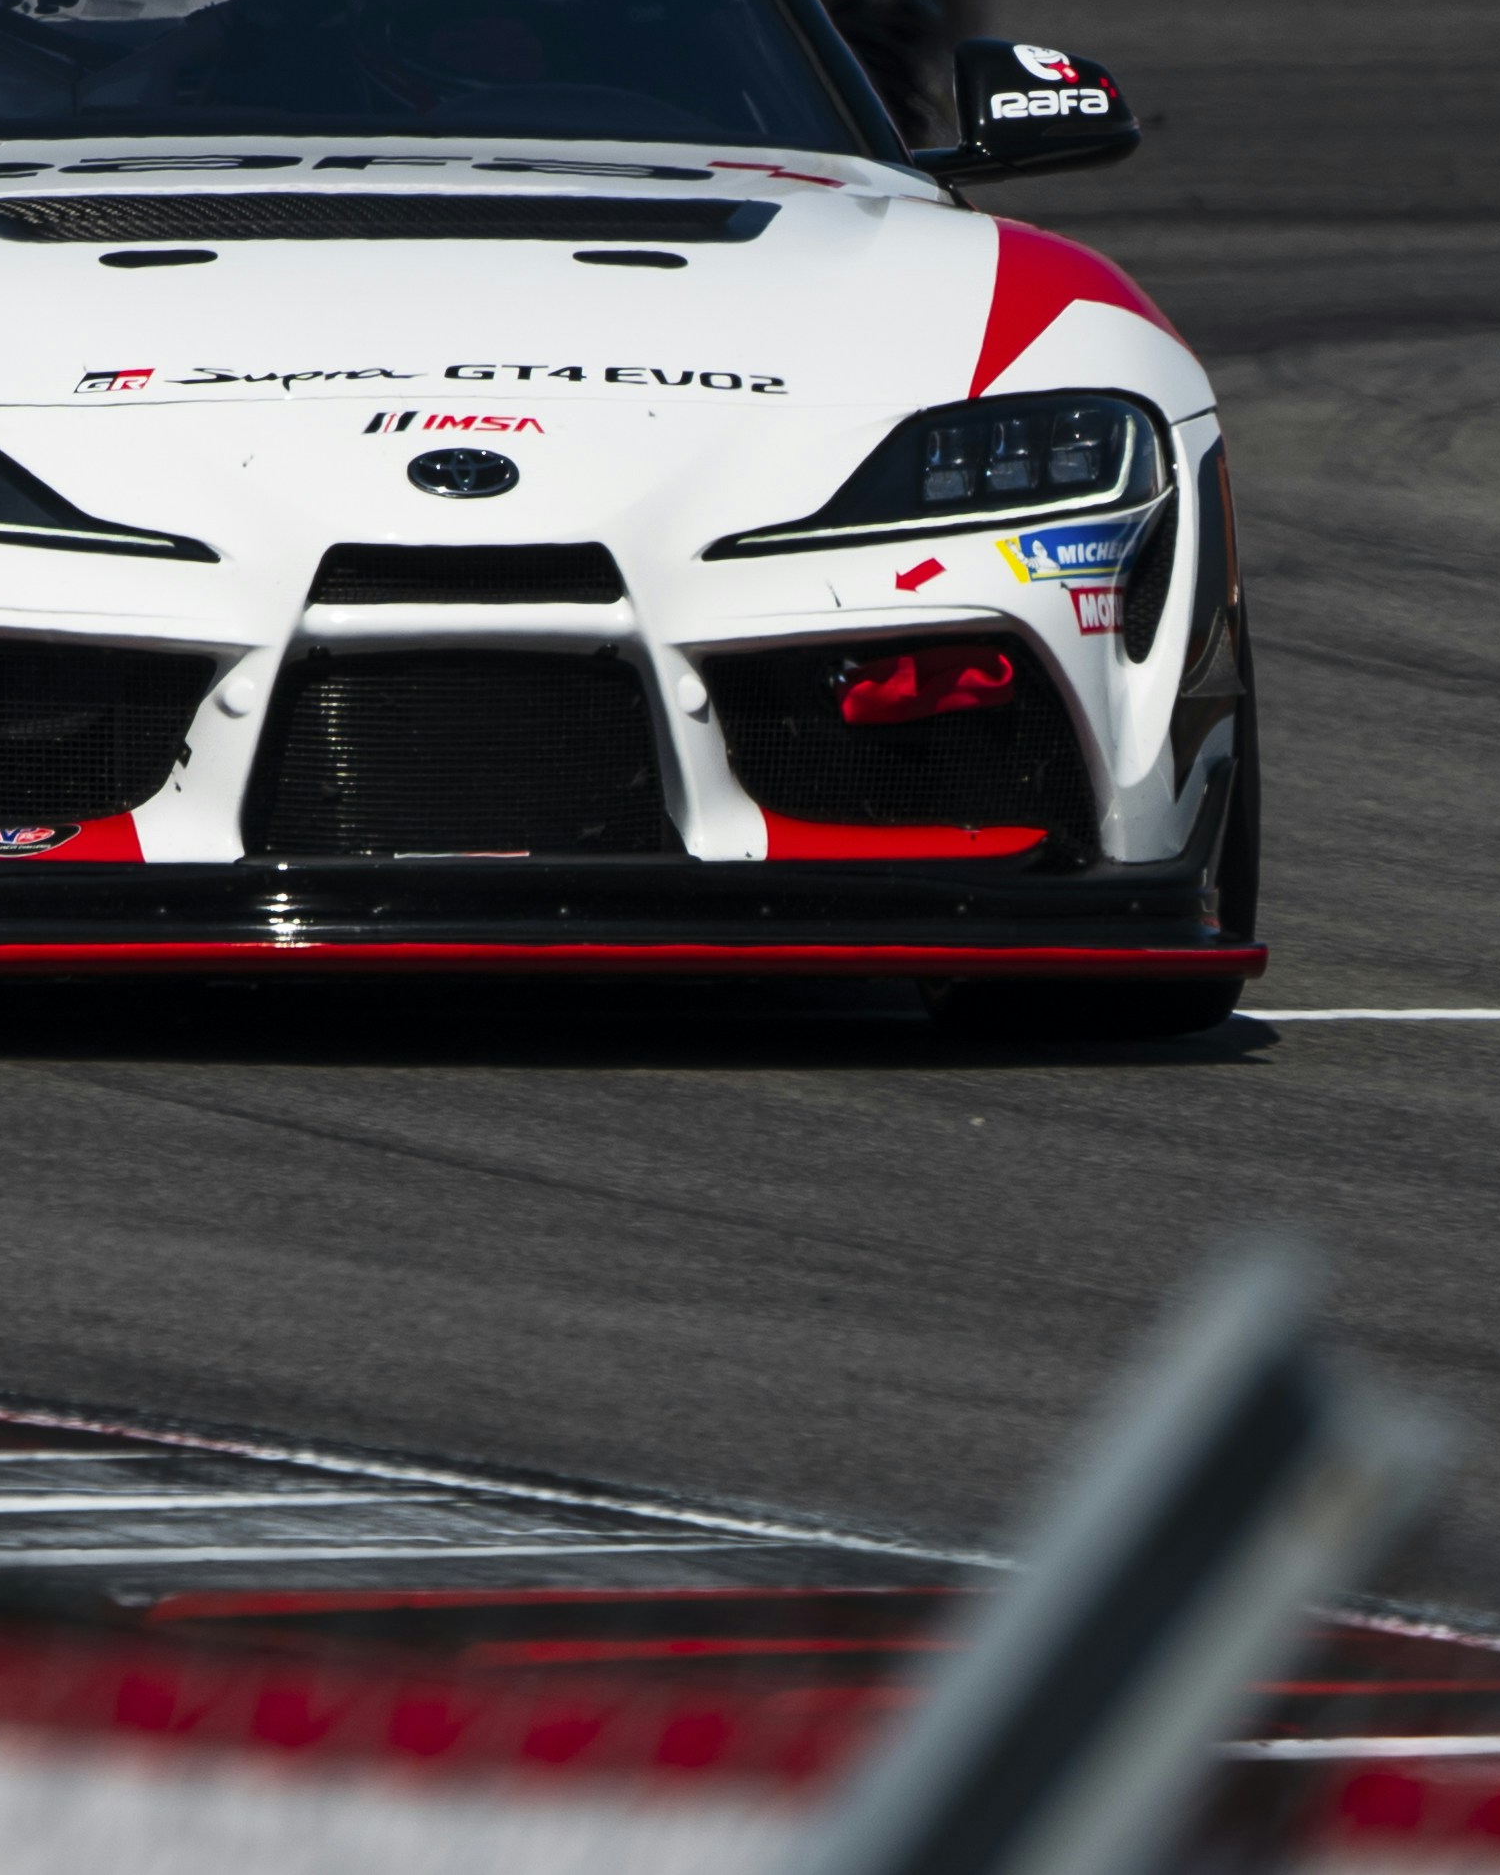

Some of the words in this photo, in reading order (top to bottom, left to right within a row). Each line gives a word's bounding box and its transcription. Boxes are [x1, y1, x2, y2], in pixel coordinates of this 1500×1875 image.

[75, 372, 152, 393] GR
[163, 367, 428, 392] Supra
[443, 364, 587, 383] GT4
[604, 366, 790, 395] EVO2
[422, 414, 546, 435] IMSA
